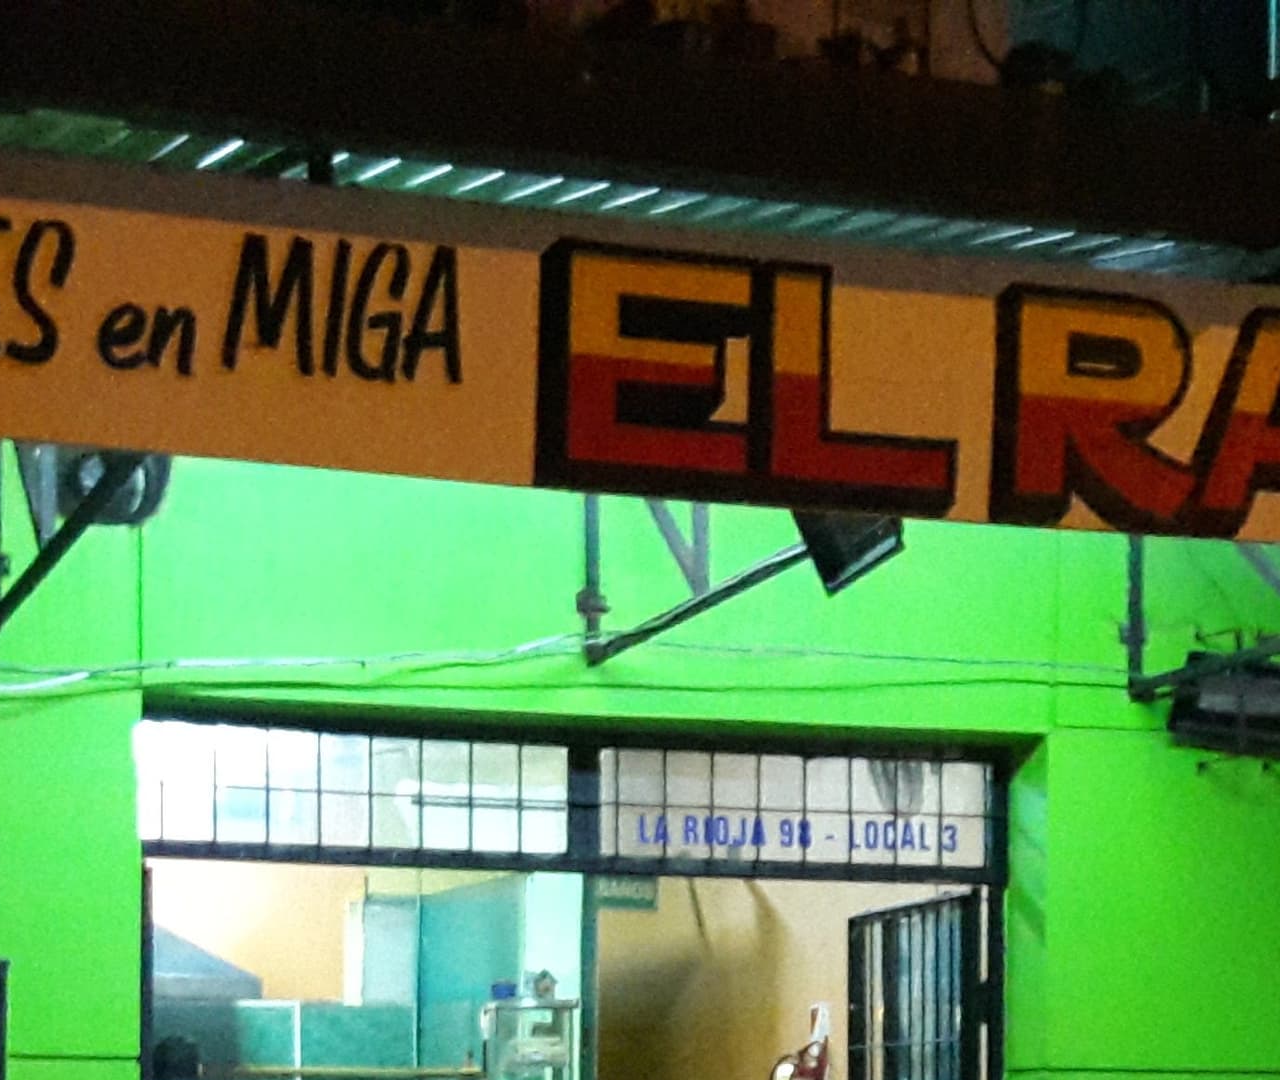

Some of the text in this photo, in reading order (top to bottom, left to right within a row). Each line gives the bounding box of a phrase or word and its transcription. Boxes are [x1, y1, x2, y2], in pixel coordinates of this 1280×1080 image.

[98, 302, 196, 376] en
[223, 233, 463, 384] MIGA
[534, 237, 958, 514] EL
[638, 814, 670, 844] LA
[684, 815, 766, 848] RIOJA
[850, 819, 930, 852] LOCAL
[942, 824, 959, 853] 3
